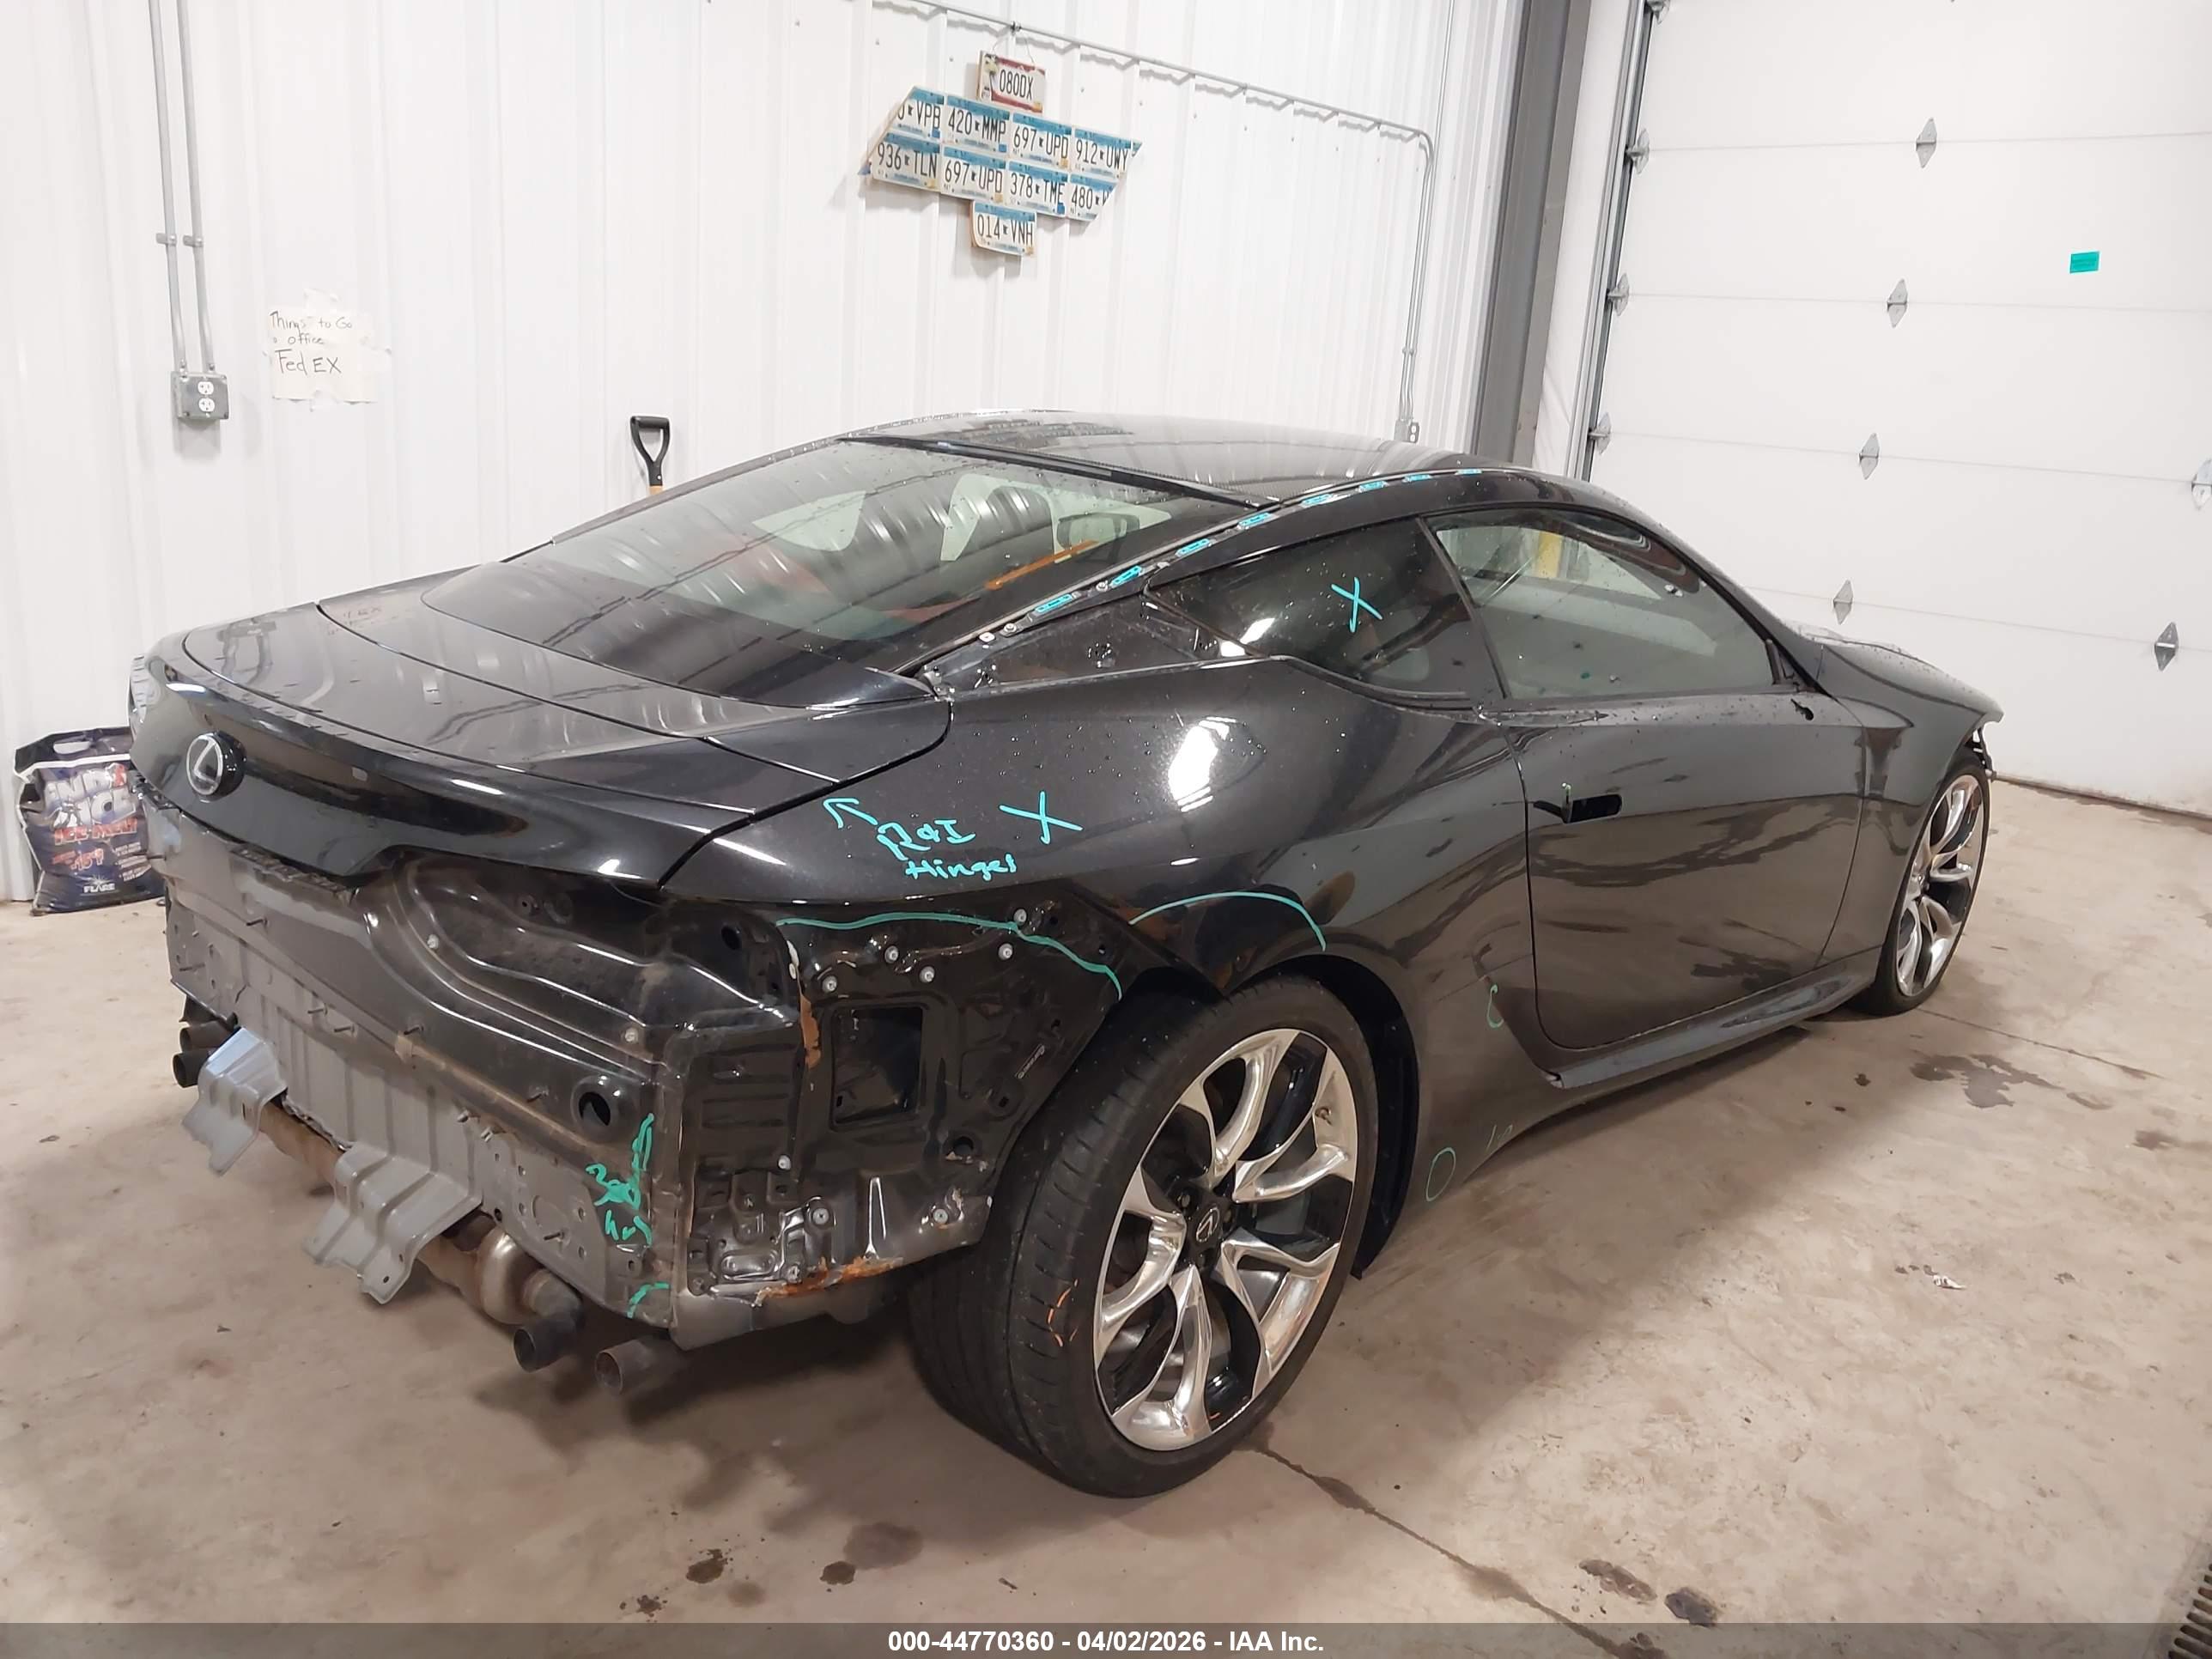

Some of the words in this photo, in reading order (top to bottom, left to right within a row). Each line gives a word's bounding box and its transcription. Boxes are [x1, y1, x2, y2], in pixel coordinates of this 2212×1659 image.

[948, 108, 973, 135] 420
[981, 115, 1006, 143] MMP
[1014, 126, 1036, 151] 697
[878, 143, 902, 170] 936
[914, 149, 938, 179] TLN
[1076, 139, 1097, 165] 912
[945, 160, 969, 185] 697
[1010, 173, 1033, 198] 378
[1043, 179, 1065, 205] TME
[1071, 185, 1093, 210] 480
[977, 213, 1000, 240] 014
[1011, 219, 1033, 248] VNH
[269, 310, 307, 337] Things
[319, 318, 331, 329] to
[335, 316, 353, 329] Go
[288, 332, 325, 344] office
[275, 348, 307, 376] Fed
